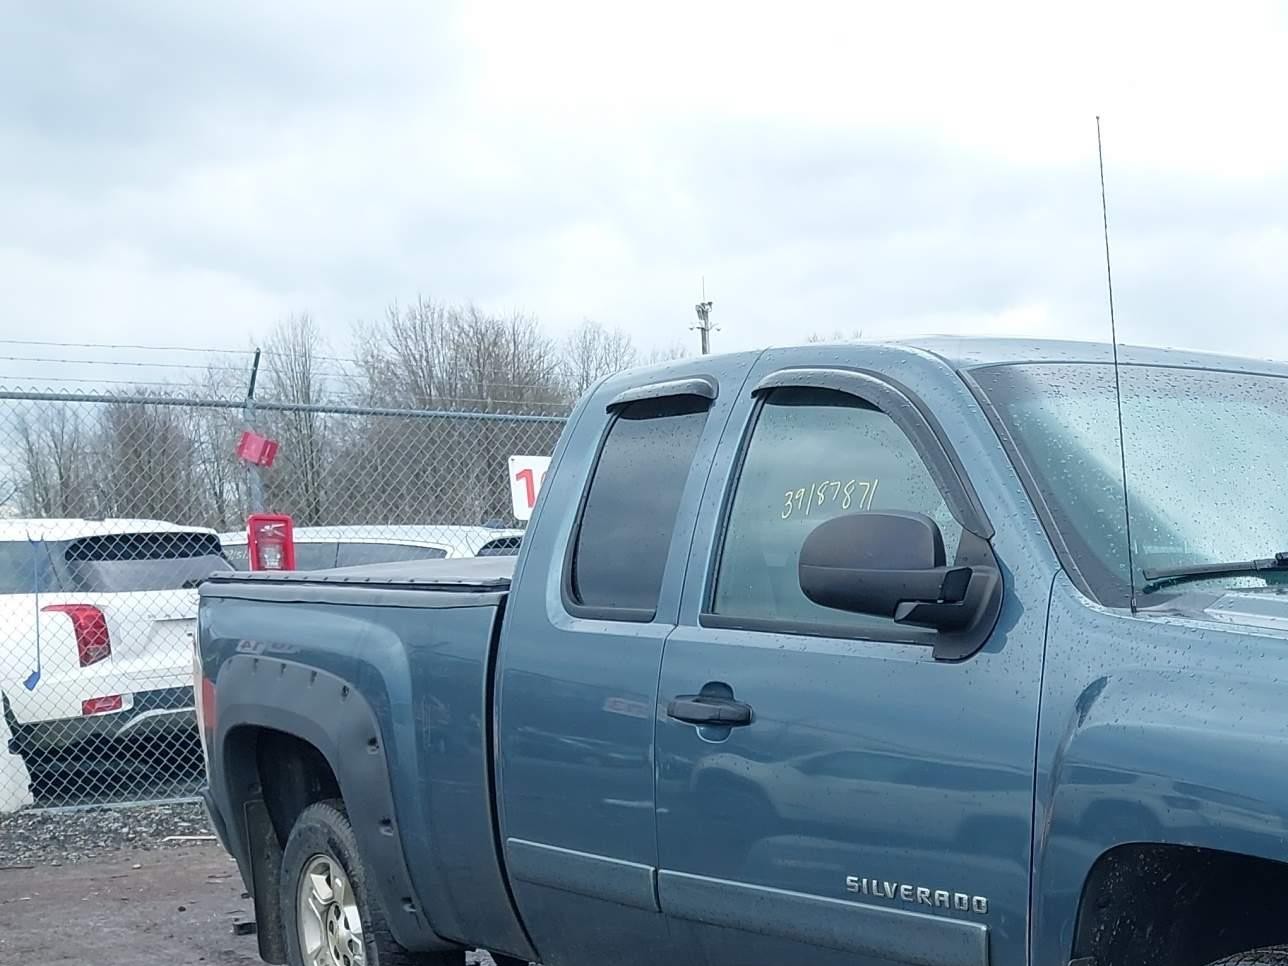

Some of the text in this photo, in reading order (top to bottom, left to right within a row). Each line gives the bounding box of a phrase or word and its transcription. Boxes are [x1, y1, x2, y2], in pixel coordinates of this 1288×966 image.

[515, 469, 547, 508] 1
[781, 479, 879, 519] 39187871
[845, 875, 989, 914] SILVERADO
